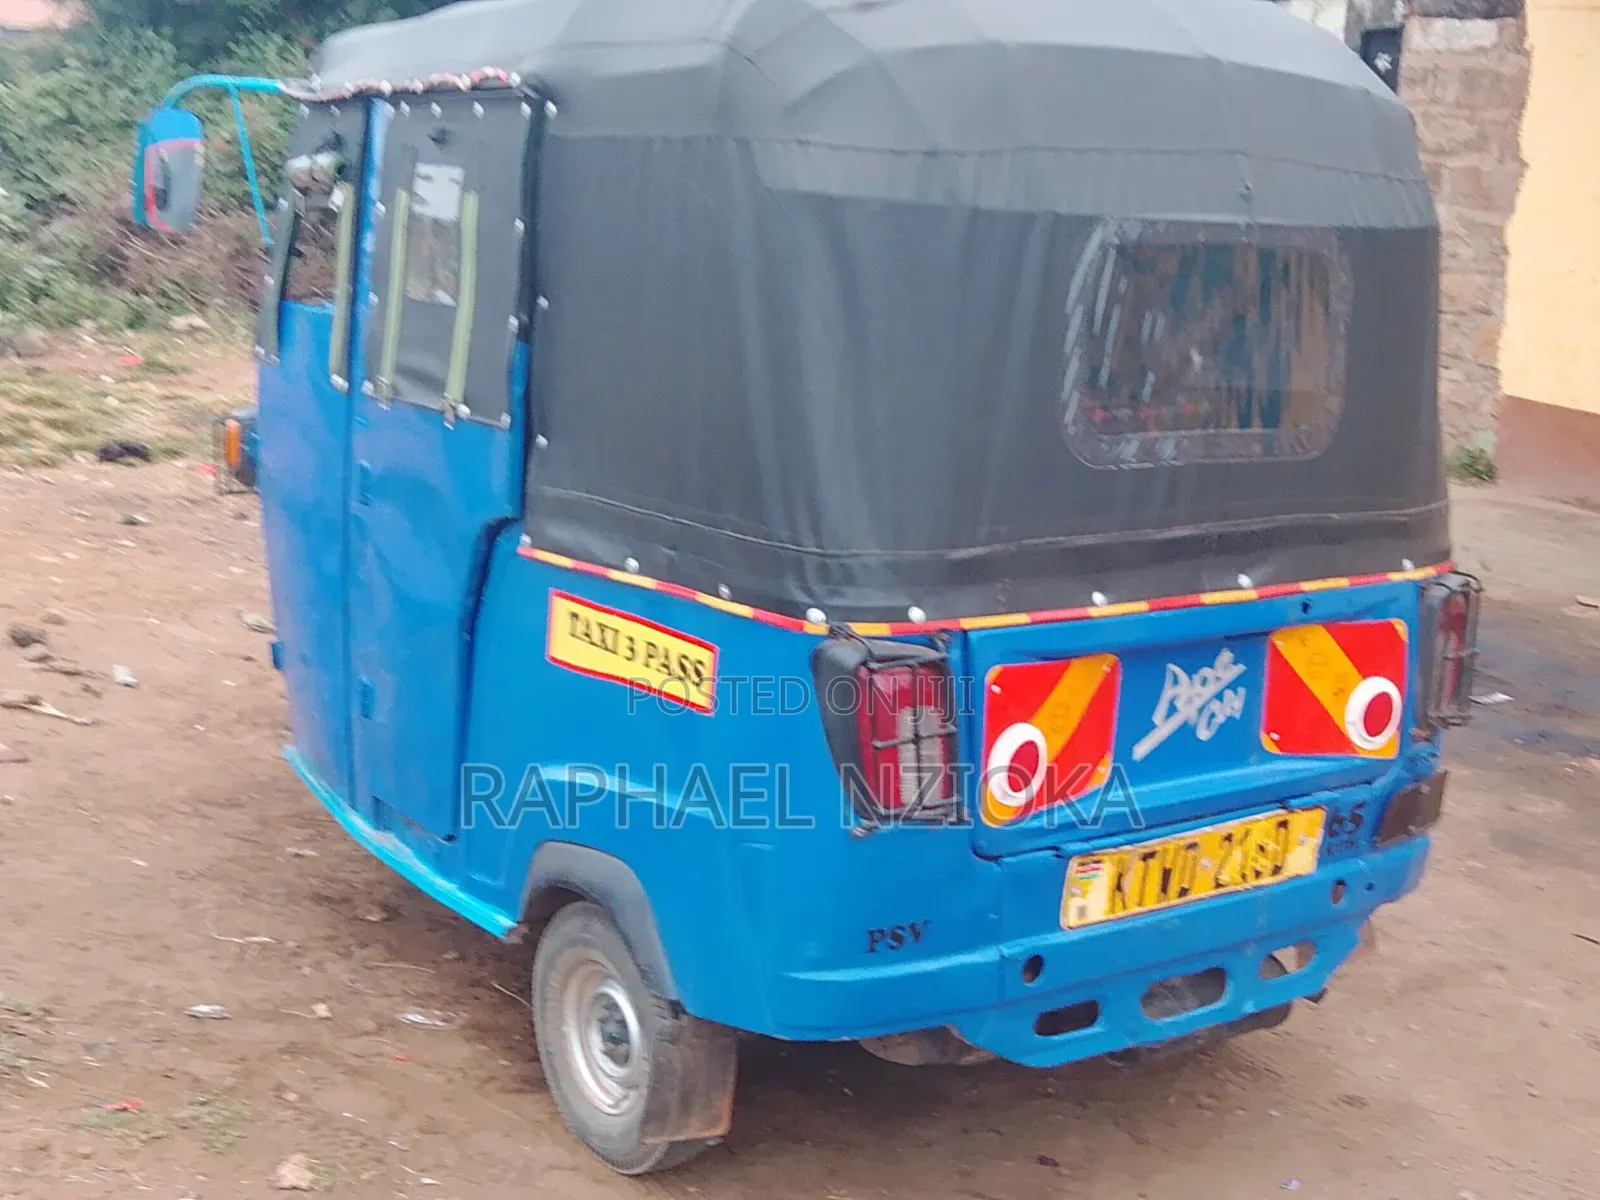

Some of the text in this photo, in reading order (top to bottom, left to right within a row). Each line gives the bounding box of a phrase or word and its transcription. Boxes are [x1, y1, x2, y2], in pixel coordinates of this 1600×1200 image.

[568, 611, 707, 688] TAXI 3 PASS
[865, 919, 931, 955] PSV
